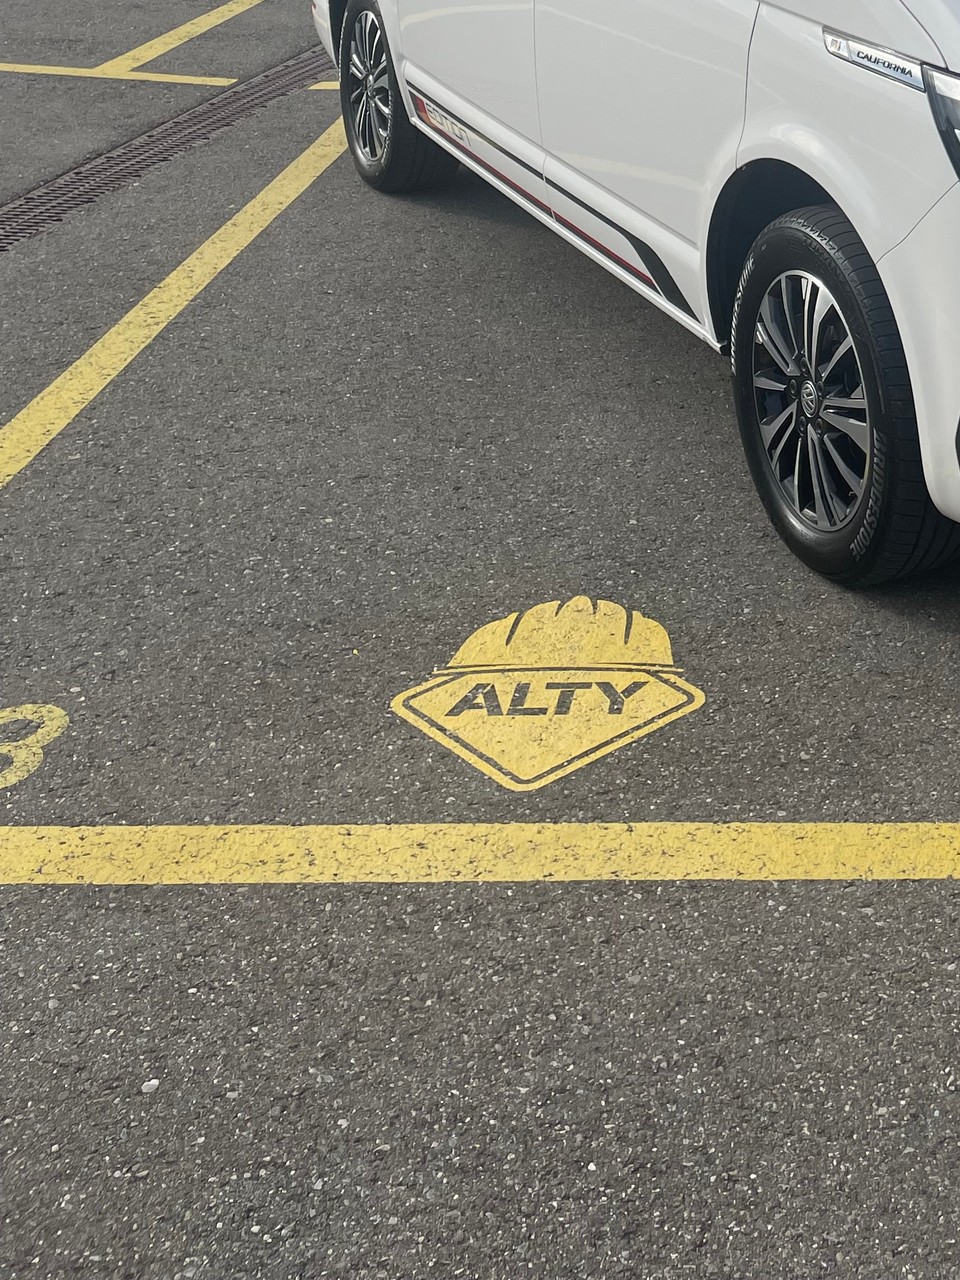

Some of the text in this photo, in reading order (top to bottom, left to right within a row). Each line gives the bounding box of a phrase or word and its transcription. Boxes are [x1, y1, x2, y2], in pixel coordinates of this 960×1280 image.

[856, 50, 913, 78] CALIFORNIA
[425, 102, 471, 148] EDITION
[849, 427, 888, 561] BRIDGESTONE
[445, 681, 649, 717] ALTY
